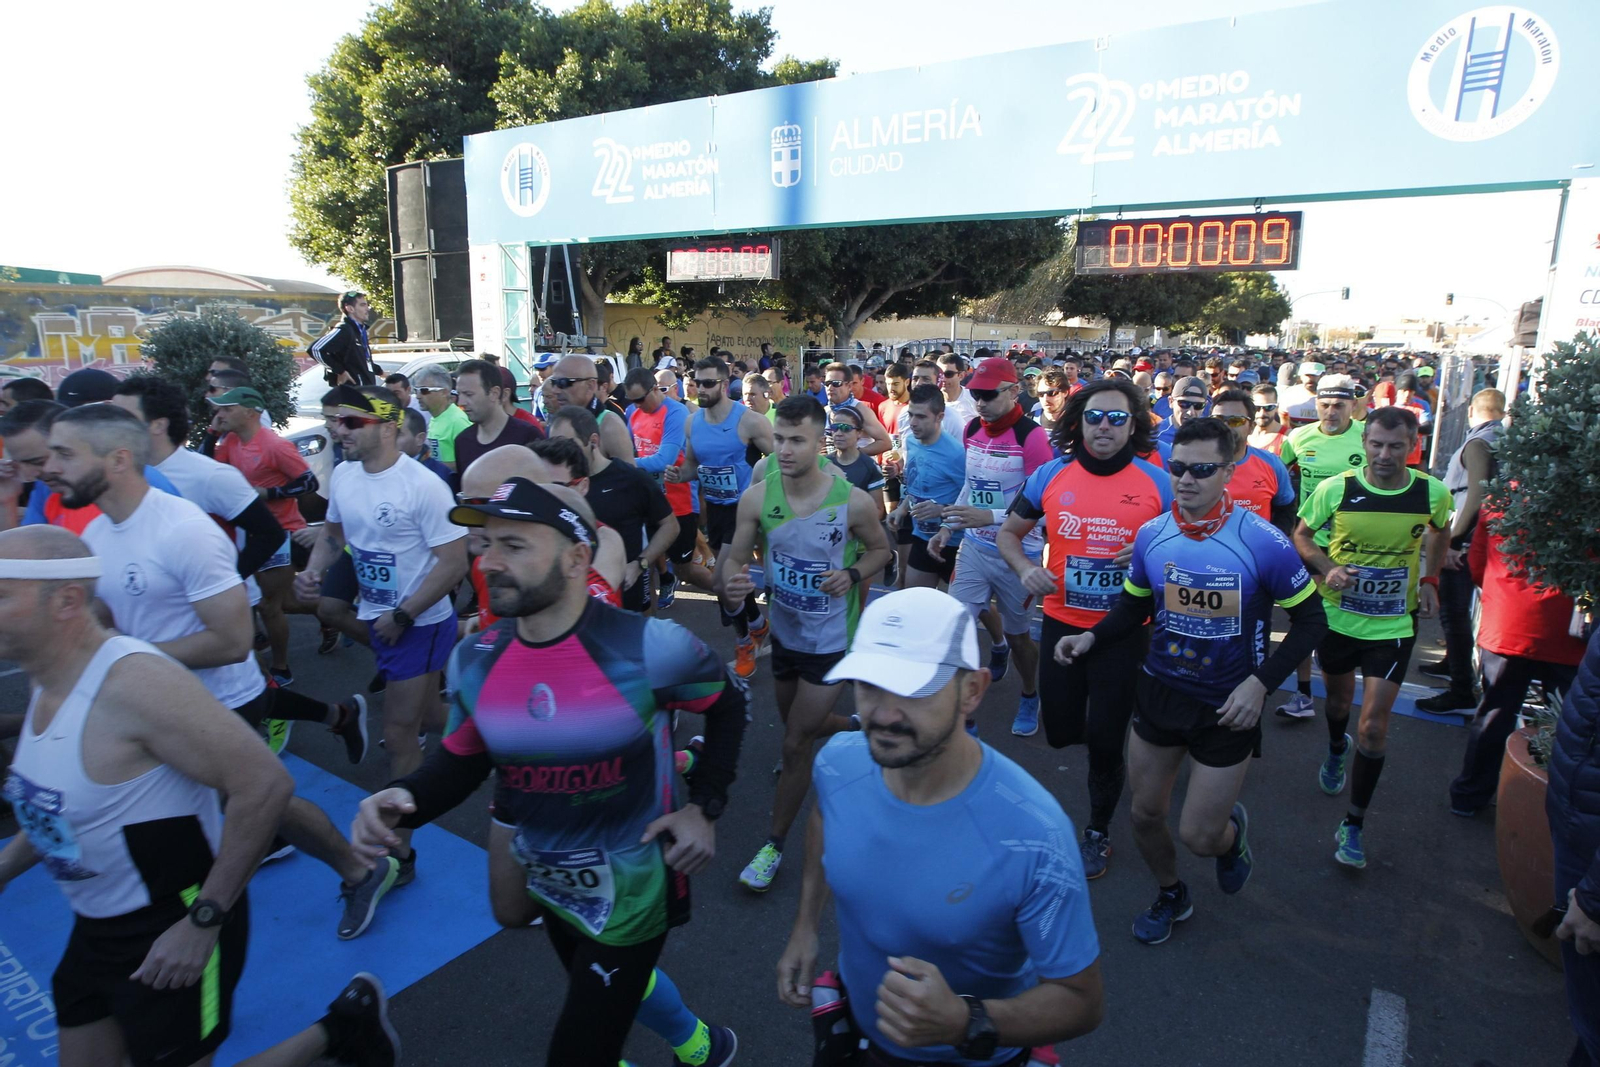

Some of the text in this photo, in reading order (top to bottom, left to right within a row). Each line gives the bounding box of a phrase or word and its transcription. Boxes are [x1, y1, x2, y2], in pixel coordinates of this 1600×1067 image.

[1420, 27, 1457, 63] Medio
[1156, 70, 1249, 102] MEDIO
[1154, 89, 1302, 130] MARATÓN
[830, 98, 983, 152] ALMERÍA
[641, 139, 691, 160] MEDIO
[1152, 120, 1282, 157] ALMERÍA
[642, 154, 719, 180] MARATÓN
[829, 152, 903, 177] CIUDAD
[643, 175, 711, 200] ALMERÍA
[1109, 218, 1291, 268] 00:00:09
[703, 475, 730, 485] 2311
[1087, 517, 1117, 527] MEDIO
[1087, 525, 1133, 537] MARATÓN
[1086, 533, 1126, 544] ALMERÍA
[778, 566, 822, 590] 1816
[1073, 570, 1124, 588] 1788
[1353, 578, 1402, 595] 1022
[1178, 587, 1223, 610] 940
